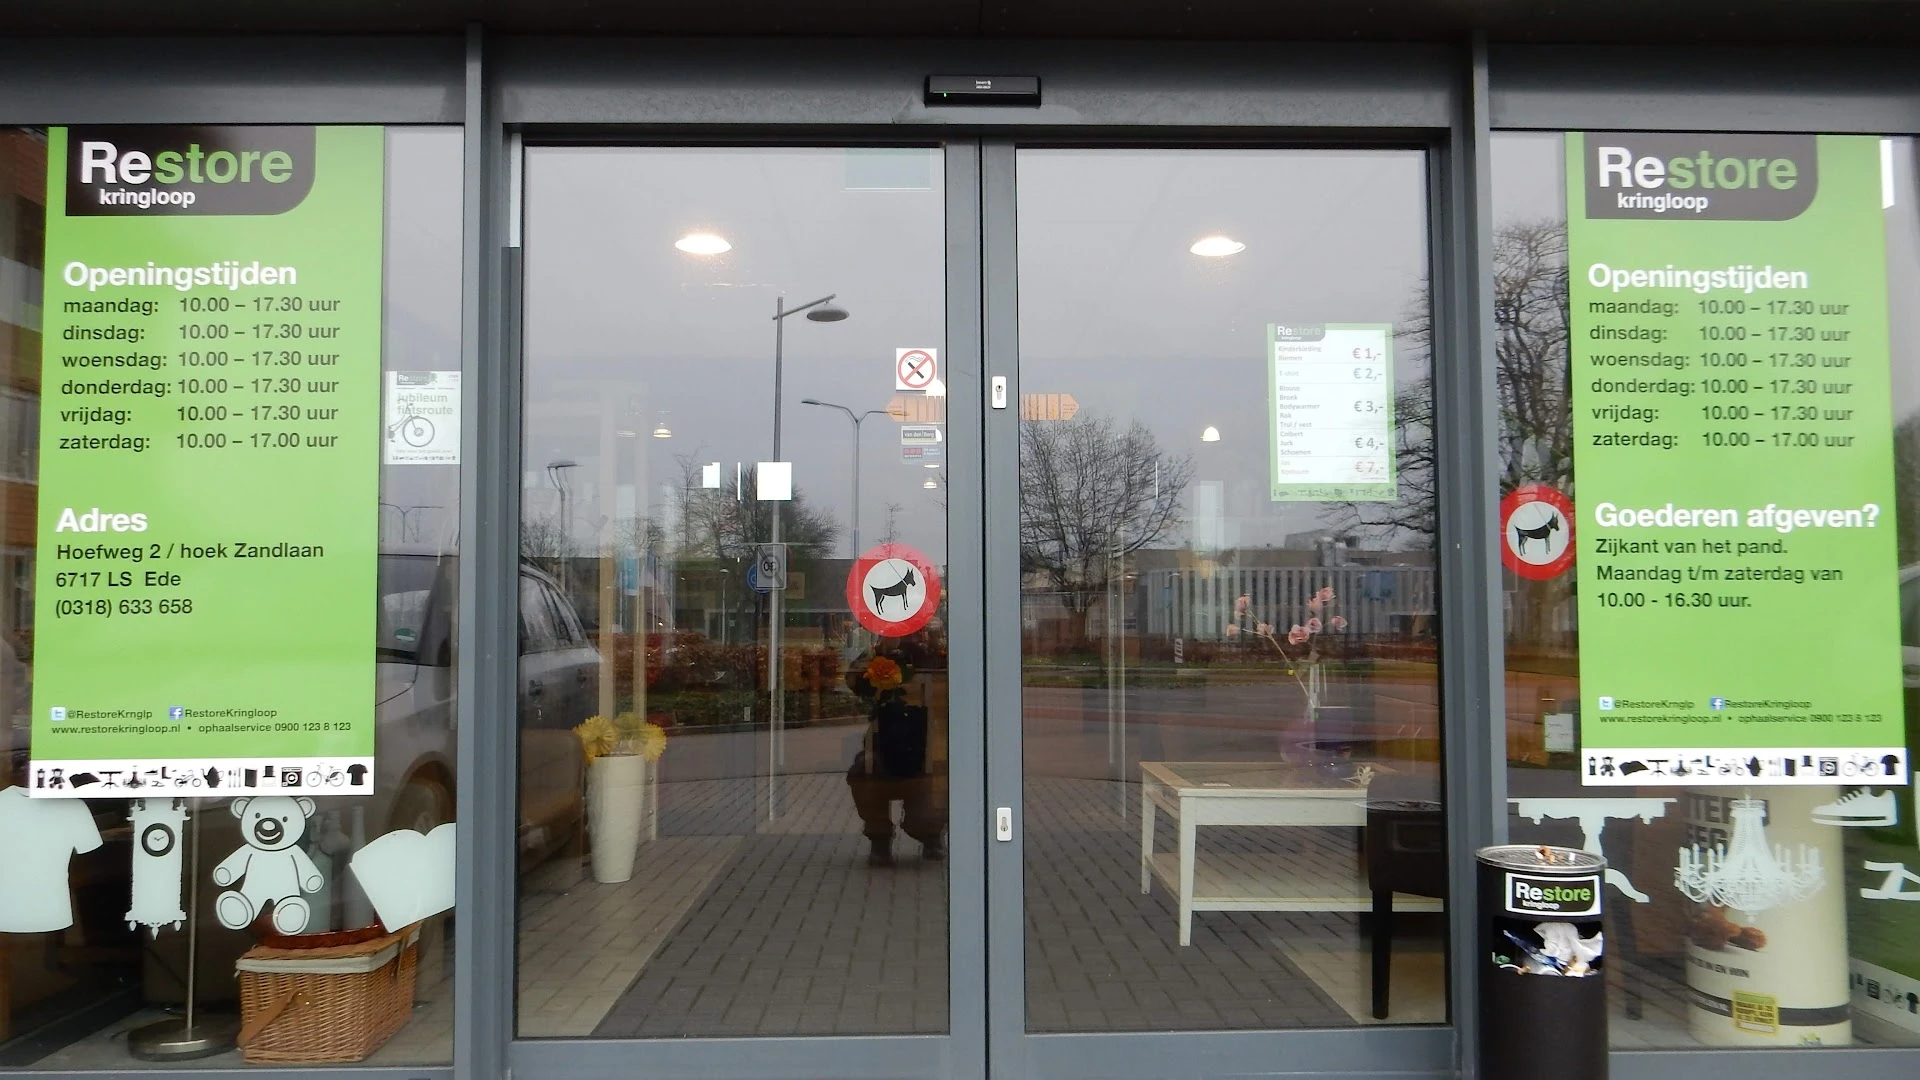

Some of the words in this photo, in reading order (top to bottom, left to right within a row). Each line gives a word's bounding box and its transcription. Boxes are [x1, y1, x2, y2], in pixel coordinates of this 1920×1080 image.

[81, 141, 292, 183] Restore
[1598, 147, 1797, 190] Restore
[99, 188, 195, 209] kringloop
[1618, 193, 1708, 213] kringloop
[64, 262, 297, 291] Openingstijden
[1588, 263, 1808, 293] Openingstijden
[64, 298, 158, 316] maandag:
[180, 298, 229, 313] 10.00
[253, 297, 302, 312] 17.30
[308, 299, 340, 312] uur
[1589, 300, 1678, 317] maandag:
[1699, 301, 1745, 314] 10.00
[1768, 301, 1813, 315] 17.30
[1820, 303, 1849, 315] uur
[63, 325, 144, 343] dinsdag:
[180, 325, 229, 340] 10.00
[253, 324, 301, 339] 17.30
[308, 326, 340, 339] uur
[1590, 326, 1667, 343] dinsdag:
[1700, 327, 1745, 340] 10.00
[1768, 327, 1814, 341] 17.30
[1821, 329, 1850, 341] uur
[63, 353, 167, 370] woensdag:
[179, 353, 228, 368] 10.00
[252, 352, 301, 367] 17.30
[307, 354, 339, 367] uur
[1353, 348, 1360, 358] €
[1591, 353, 1689, 369] woensdag:
[1701, 353, 1746, 367] 10.00
[1769, 354, 1816, 368] 17.30
[1822, 356, 1851, 368] uur
[1353, 368, 1361, 378] €
[61, 380, 171, 397] donderdag:
[178, 380, 228, 394] 10.00
[251, 379, 300, 394] 17.30
[306, 380, 338, 394] uur
[1591, 379, 1695, 396] donderdag:
[1701, 379, 1747, 393] 10.00
[1770, 380, 1817, 394] 17.30
[1823, 382, 1852, 394] uur
[397, 393, 447, 404] jubileum
[1280, 403, 1320, 411] Bodywarmer
[1354, 401, 1362, 411] €
[61, 407, 131, 424] vrijdag:
[177, 407, 227, 421] 10.00
[250, 406, 299, 421] 17.30
[306, 407, 337, 421] uur
[1592, 405, 1658, 423] vrijdag:
[1702, 406, 1748, 420] 10.00
[1771, 406, 1818, 420] 17.30
[1824, 408, 1853, 420] uur
[60, 434, 150, 451] zaterdag:
[177, 434, 226, 449] 10.00
[250, 433, 298, 448] 17.00
[305, 435, 337, 448] uur
[1280, 430, 1303, 438] Colbert
[1355, 438, 1362, 448] €
[1593, 432, 1678, 449] zaterdag:
[1703, 433, 1749, 446] 10.00
[1772, 433, 1819, 447] 17.00
[1825, 435, 1854, 447] uur
[1281, 448, 1311, 456] Schoenen
[56, 508, 147, 532] Adres
[1595, 503, 1737, 528] Goederen
[1747, 504, 1879, 533] afgeven?
[57, 544, 143, 561] Hoefweg
[150, 544, 161, 558] 2
[166, 544, 175, 558] /
[181, 543, 228, 558] hoek
[234, 542, 323, 558] Zandlaan
[1596, 538, 1658, 557] Zijkant
[1666, 541, 1696, 554] van
[1702, 539, 1731, 554] het
[1738, 539, 1787, 557] pand.
[56, 572, 100, 587] 6717
[108, 572, 132, 587] LS
[145, 571, 181, 586] Ede
[1597, 566, 1681, 584] Maandag
[1688, 566, 1718, 580] t/m
[1725, 566, 1804, 583] zaterdag
[1812, 568, 1842, 580] van
[56, 599, 112, 618] (0318)
[119, 599, 153, 614] 633
[159, 599, 192, 614] 658
[1598, 593, 1645, 607] 10.00
[1666, 593, 1712, 607] 16.30
[1718, 595, 1751, 607] uur.
[185, 708, 277, 719] RestoreKringloop
[1600, 713, 1721, 724] www.restorekringloop.nl
[52, 723, 180, 734] www.restorekringloop.nl
[199, 722, 271, 734] ophaalservice
[274, 722, 299, 732] 0900
[303, 722, 321, 731] 123
[324, 722, 329, 731] 8
[333, 722, 351, 731] 123
[1516, 882, 1591, 901] Restore
